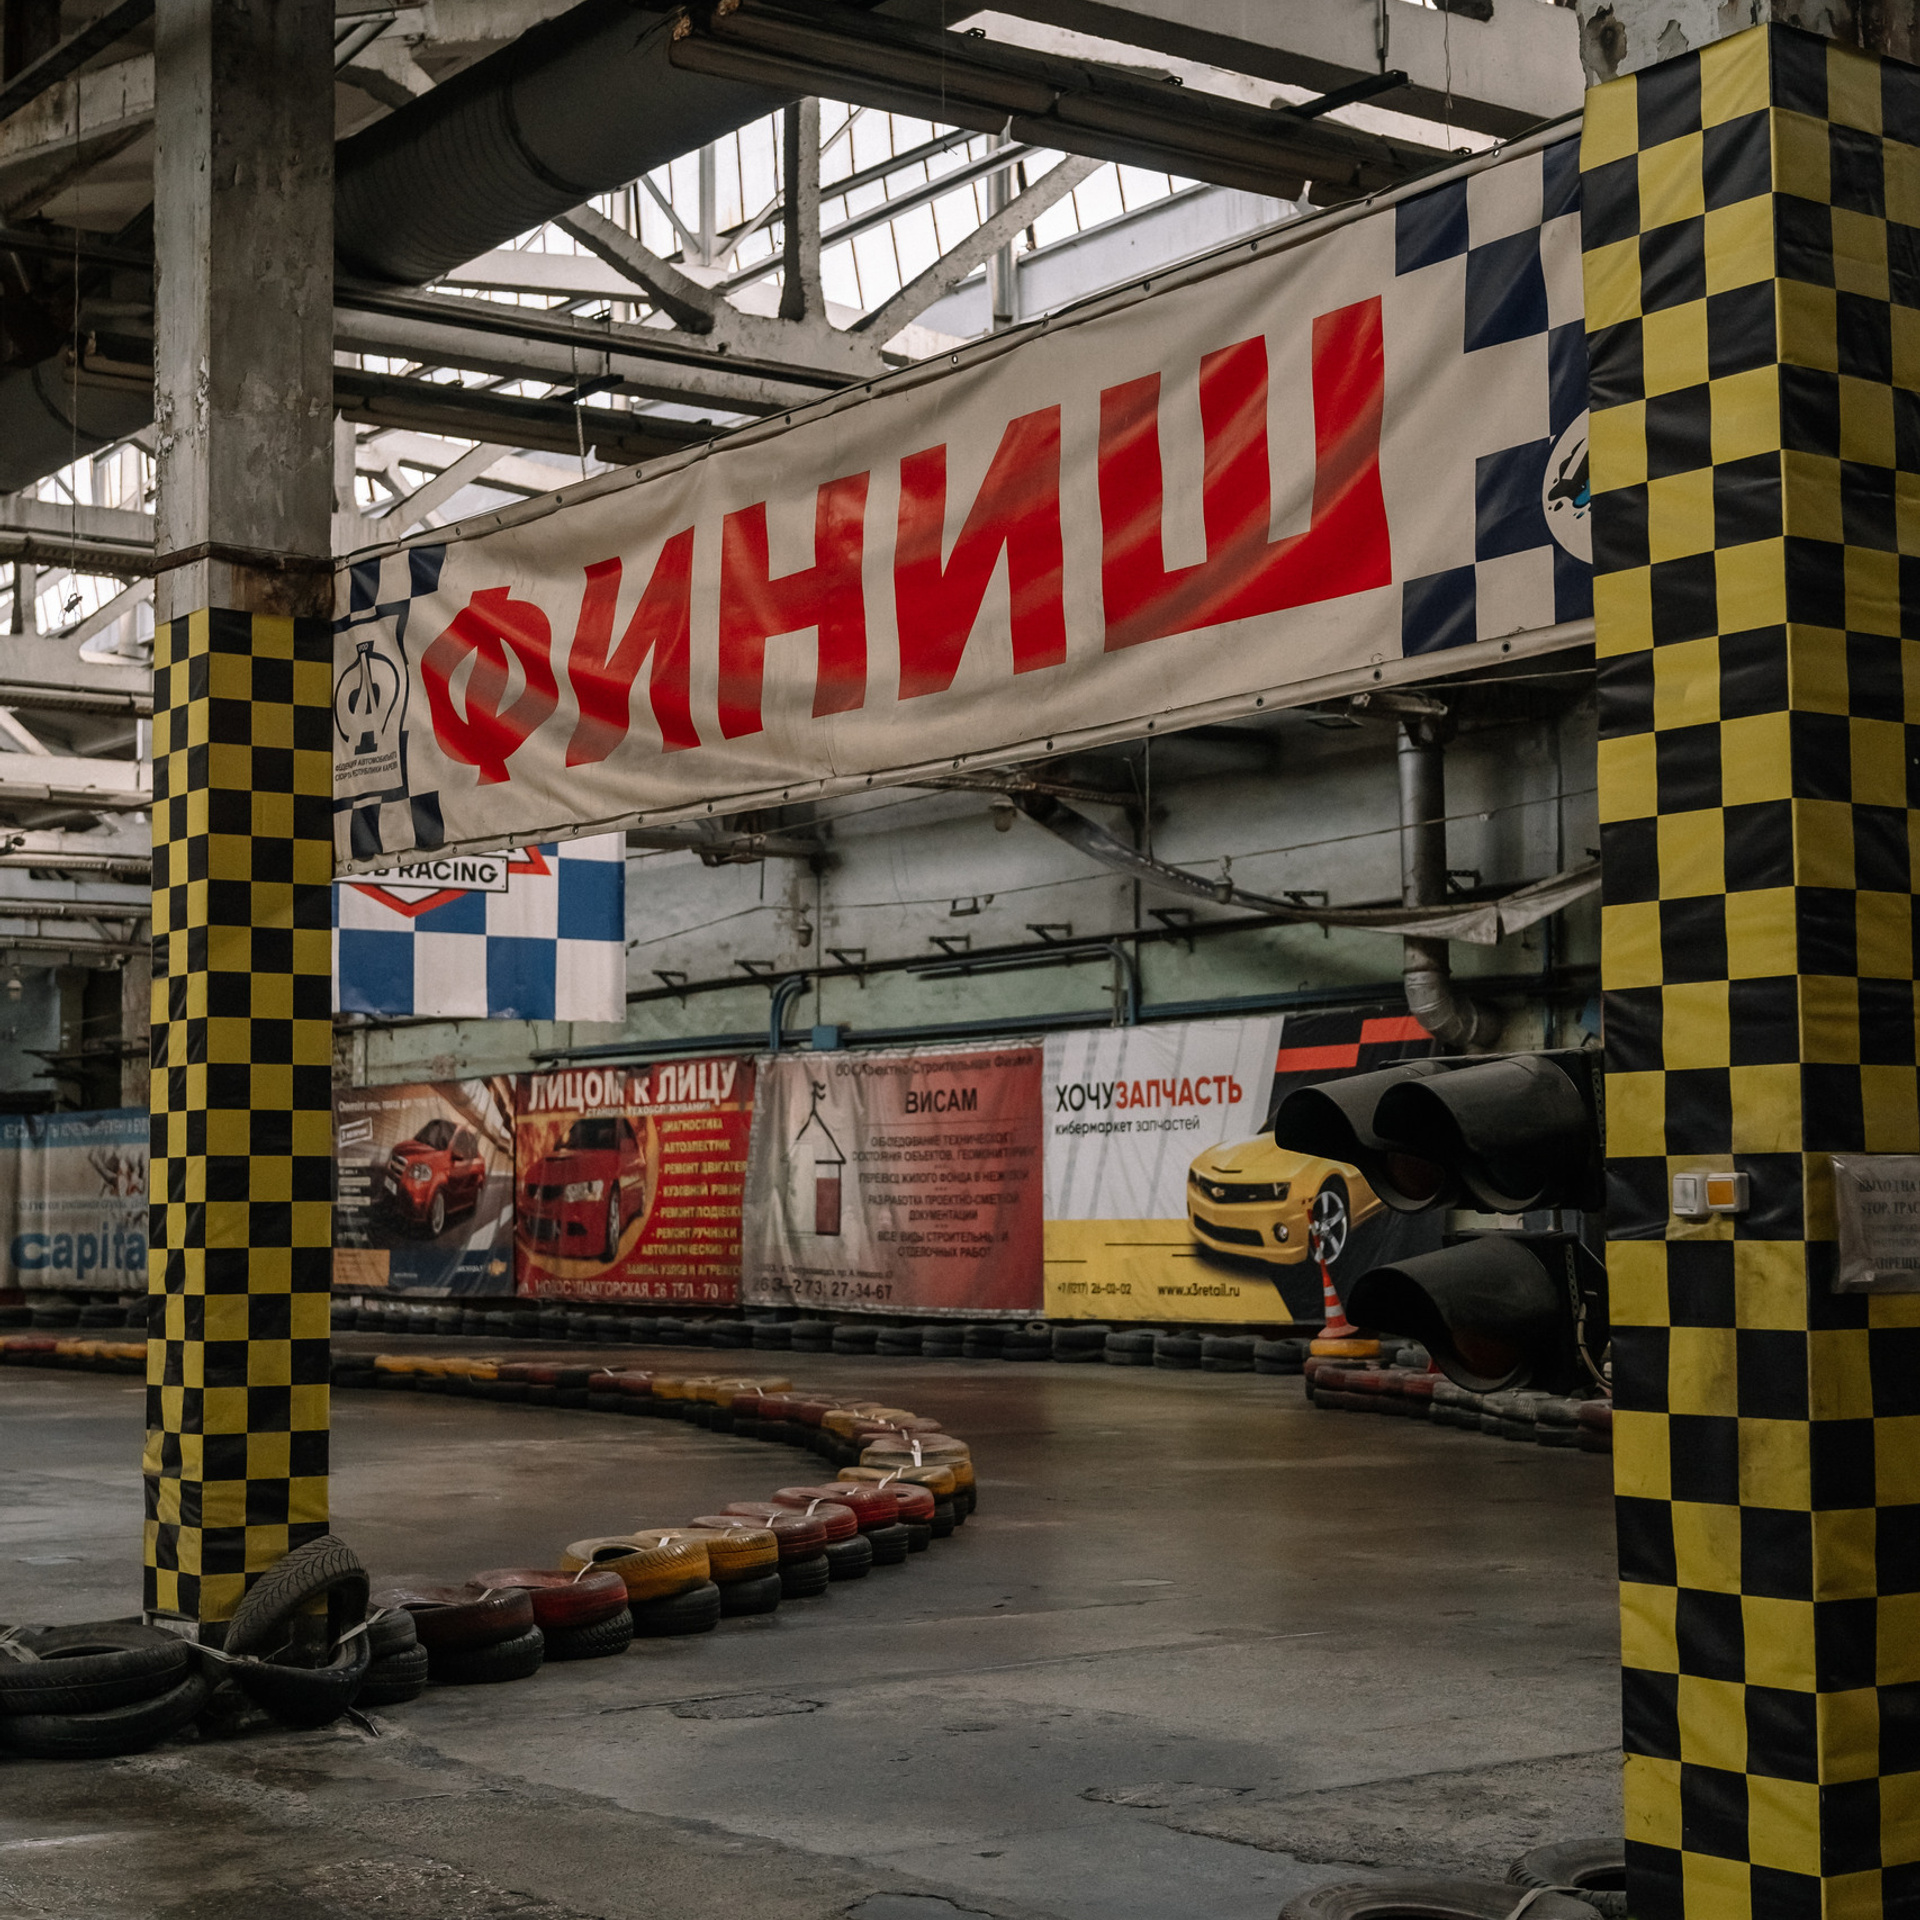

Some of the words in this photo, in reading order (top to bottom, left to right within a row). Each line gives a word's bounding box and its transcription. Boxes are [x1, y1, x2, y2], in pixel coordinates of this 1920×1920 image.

[421, 295, 1392, 786] ФИНИШ
[398, 861, 499, 883] RACING
[528, 1070, 627, 1114] ЛИЦОМ
[656, 1061, 737, 1106] ЛИЦУ
[905, 1088, 977, 1113] ВИСАМ
[1055, 1120, 1132, 1137] кибермаркет
[1136, 1115, 1200, 1132] запчастей
[831, 1281, 893, 1300] 27-34-67
[1157, 1281, 1240, 1298] www.x3retail.ru
